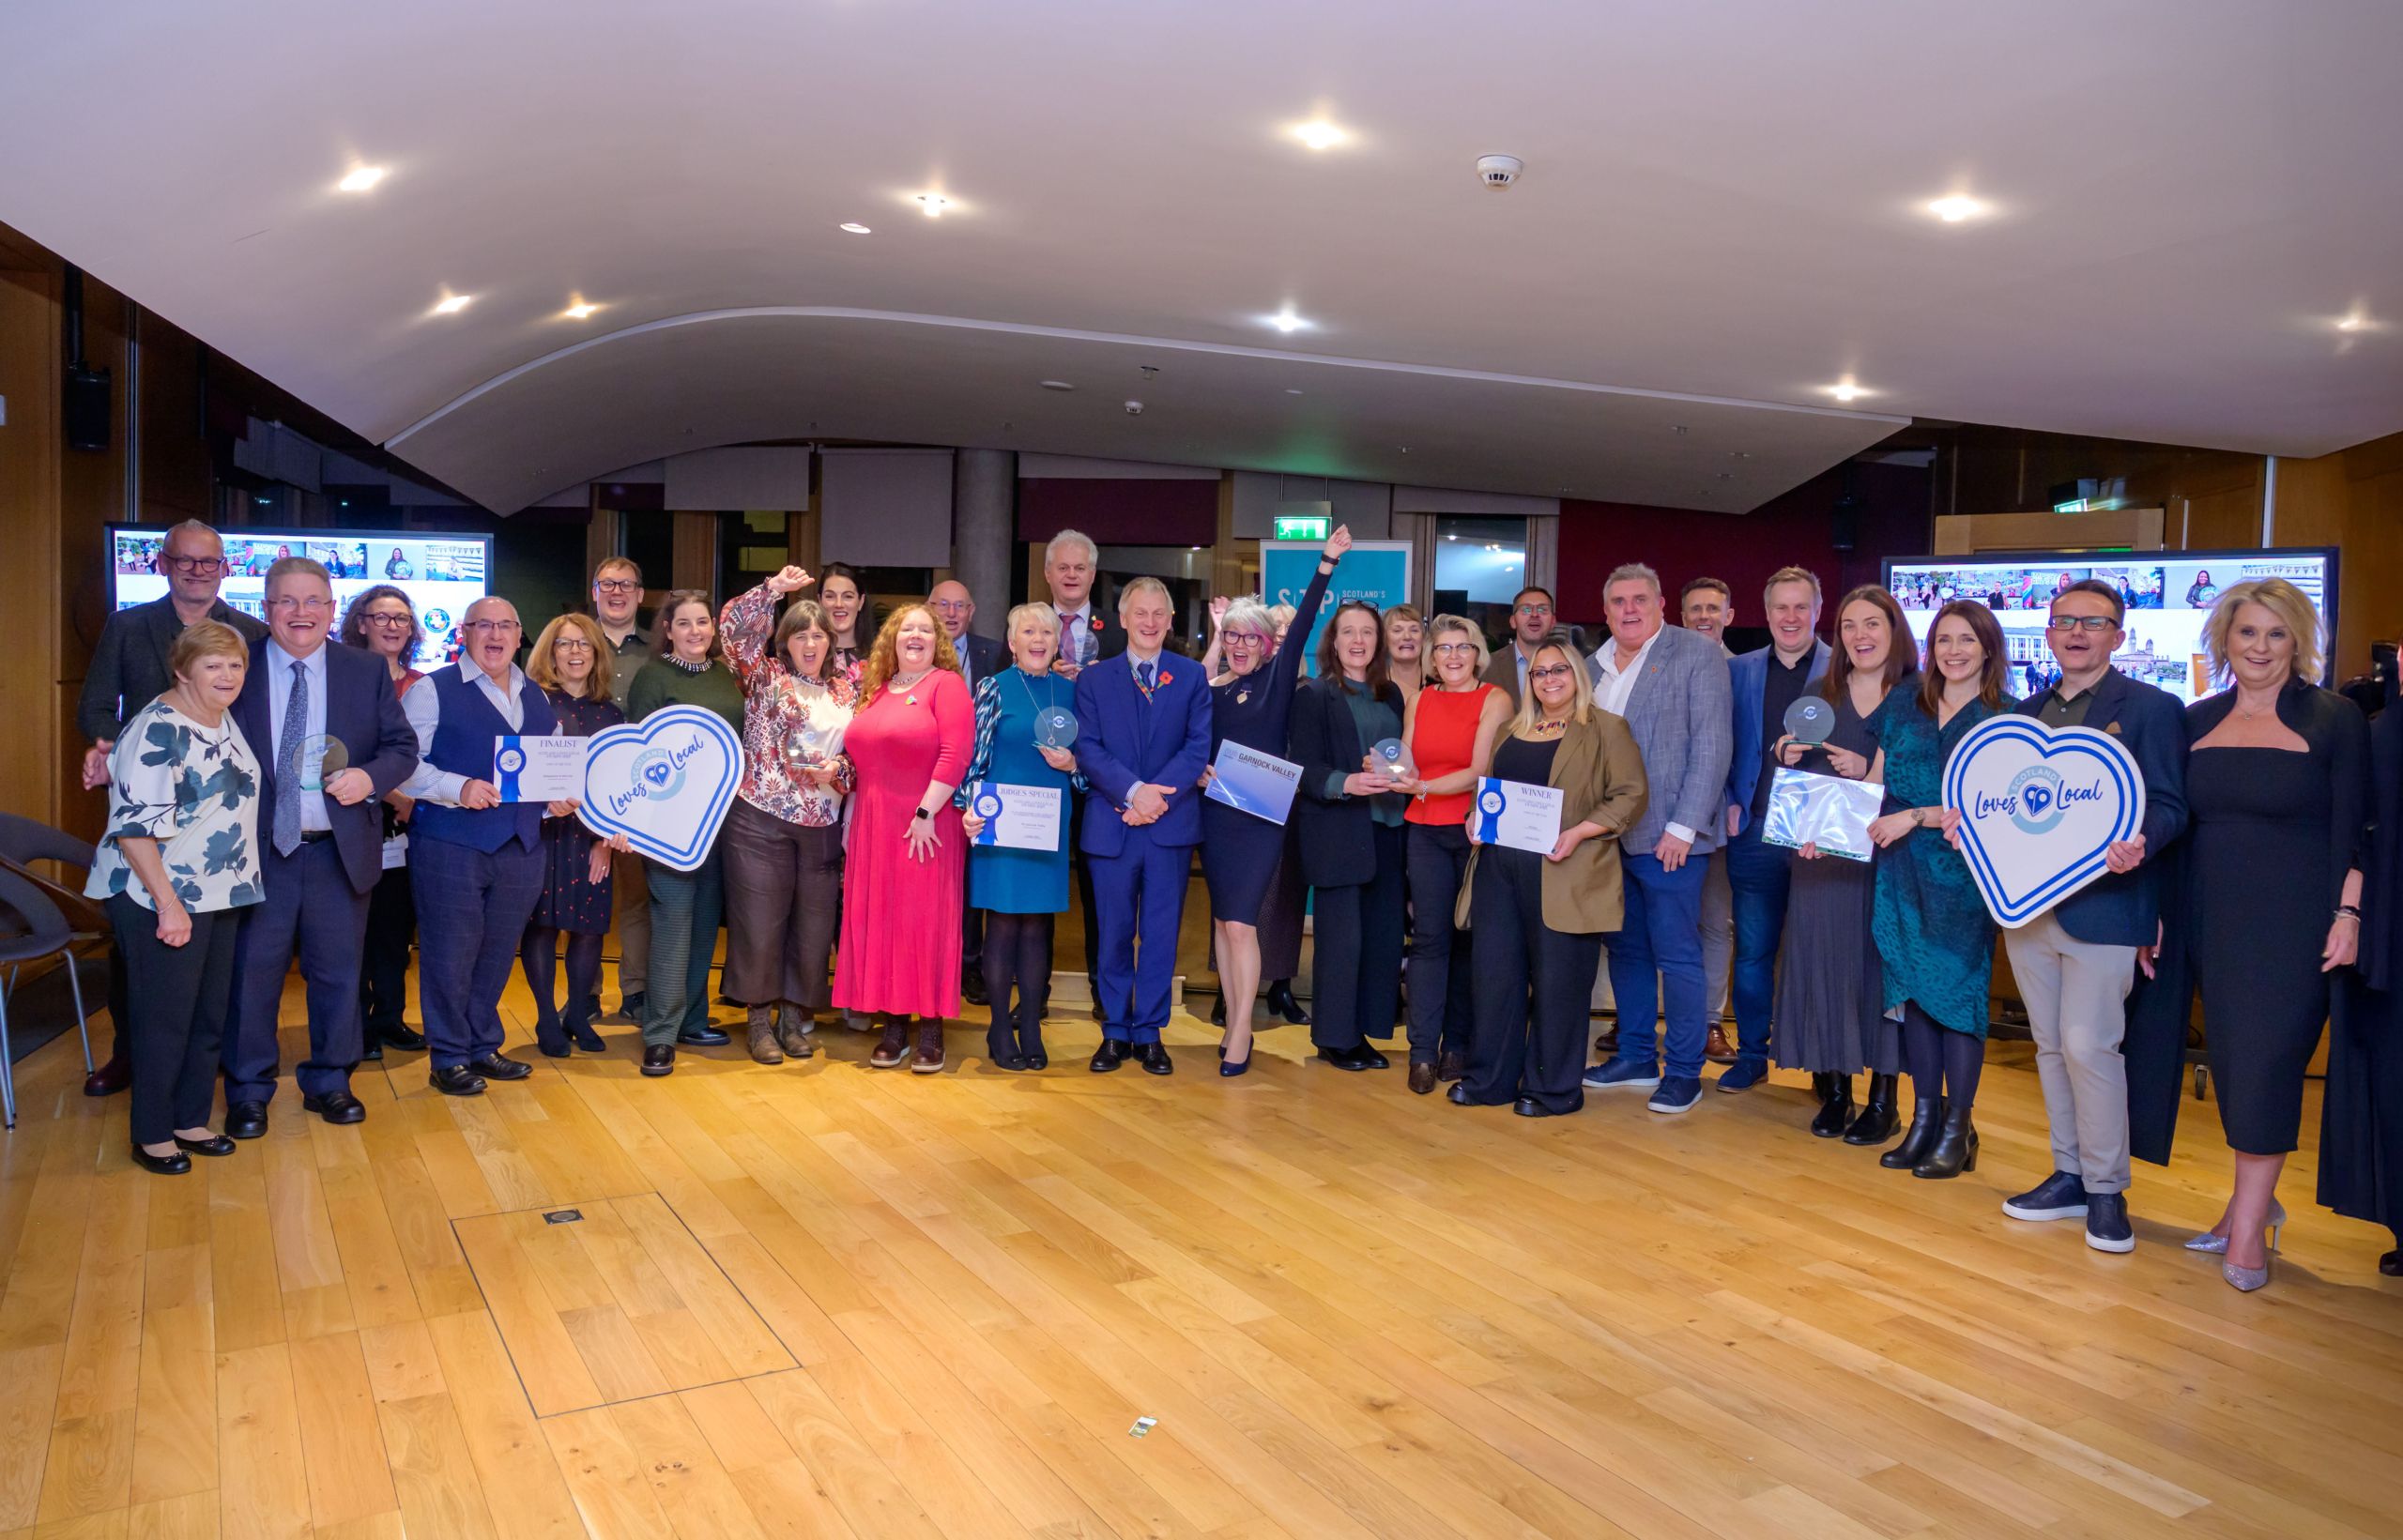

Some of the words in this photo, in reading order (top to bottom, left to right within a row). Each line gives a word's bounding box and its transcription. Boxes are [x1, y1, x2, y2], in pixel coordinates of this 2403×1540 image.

[1341, 589, 1385, 599] SCOTLAND'S
[540, 740, 578, 748] FINALIST
[1238, 753, 1271, 770] GARNOCK
[1272, 764, 1296, 779] VALLEY
[609, 782, 647, 816] Loves
[668, 735, 704, 770] Local
[2012, 768, 2058, 790] SCOTLAND
[1001, 788, 1027, 797] JUDGES
[1029, 791, 1059, 800] SPECIAL
[1521, 786, 1553, 800] WINNER
[1975, 790, 2018, 819] Loves
[2057, 779, 2103, 810] Local
